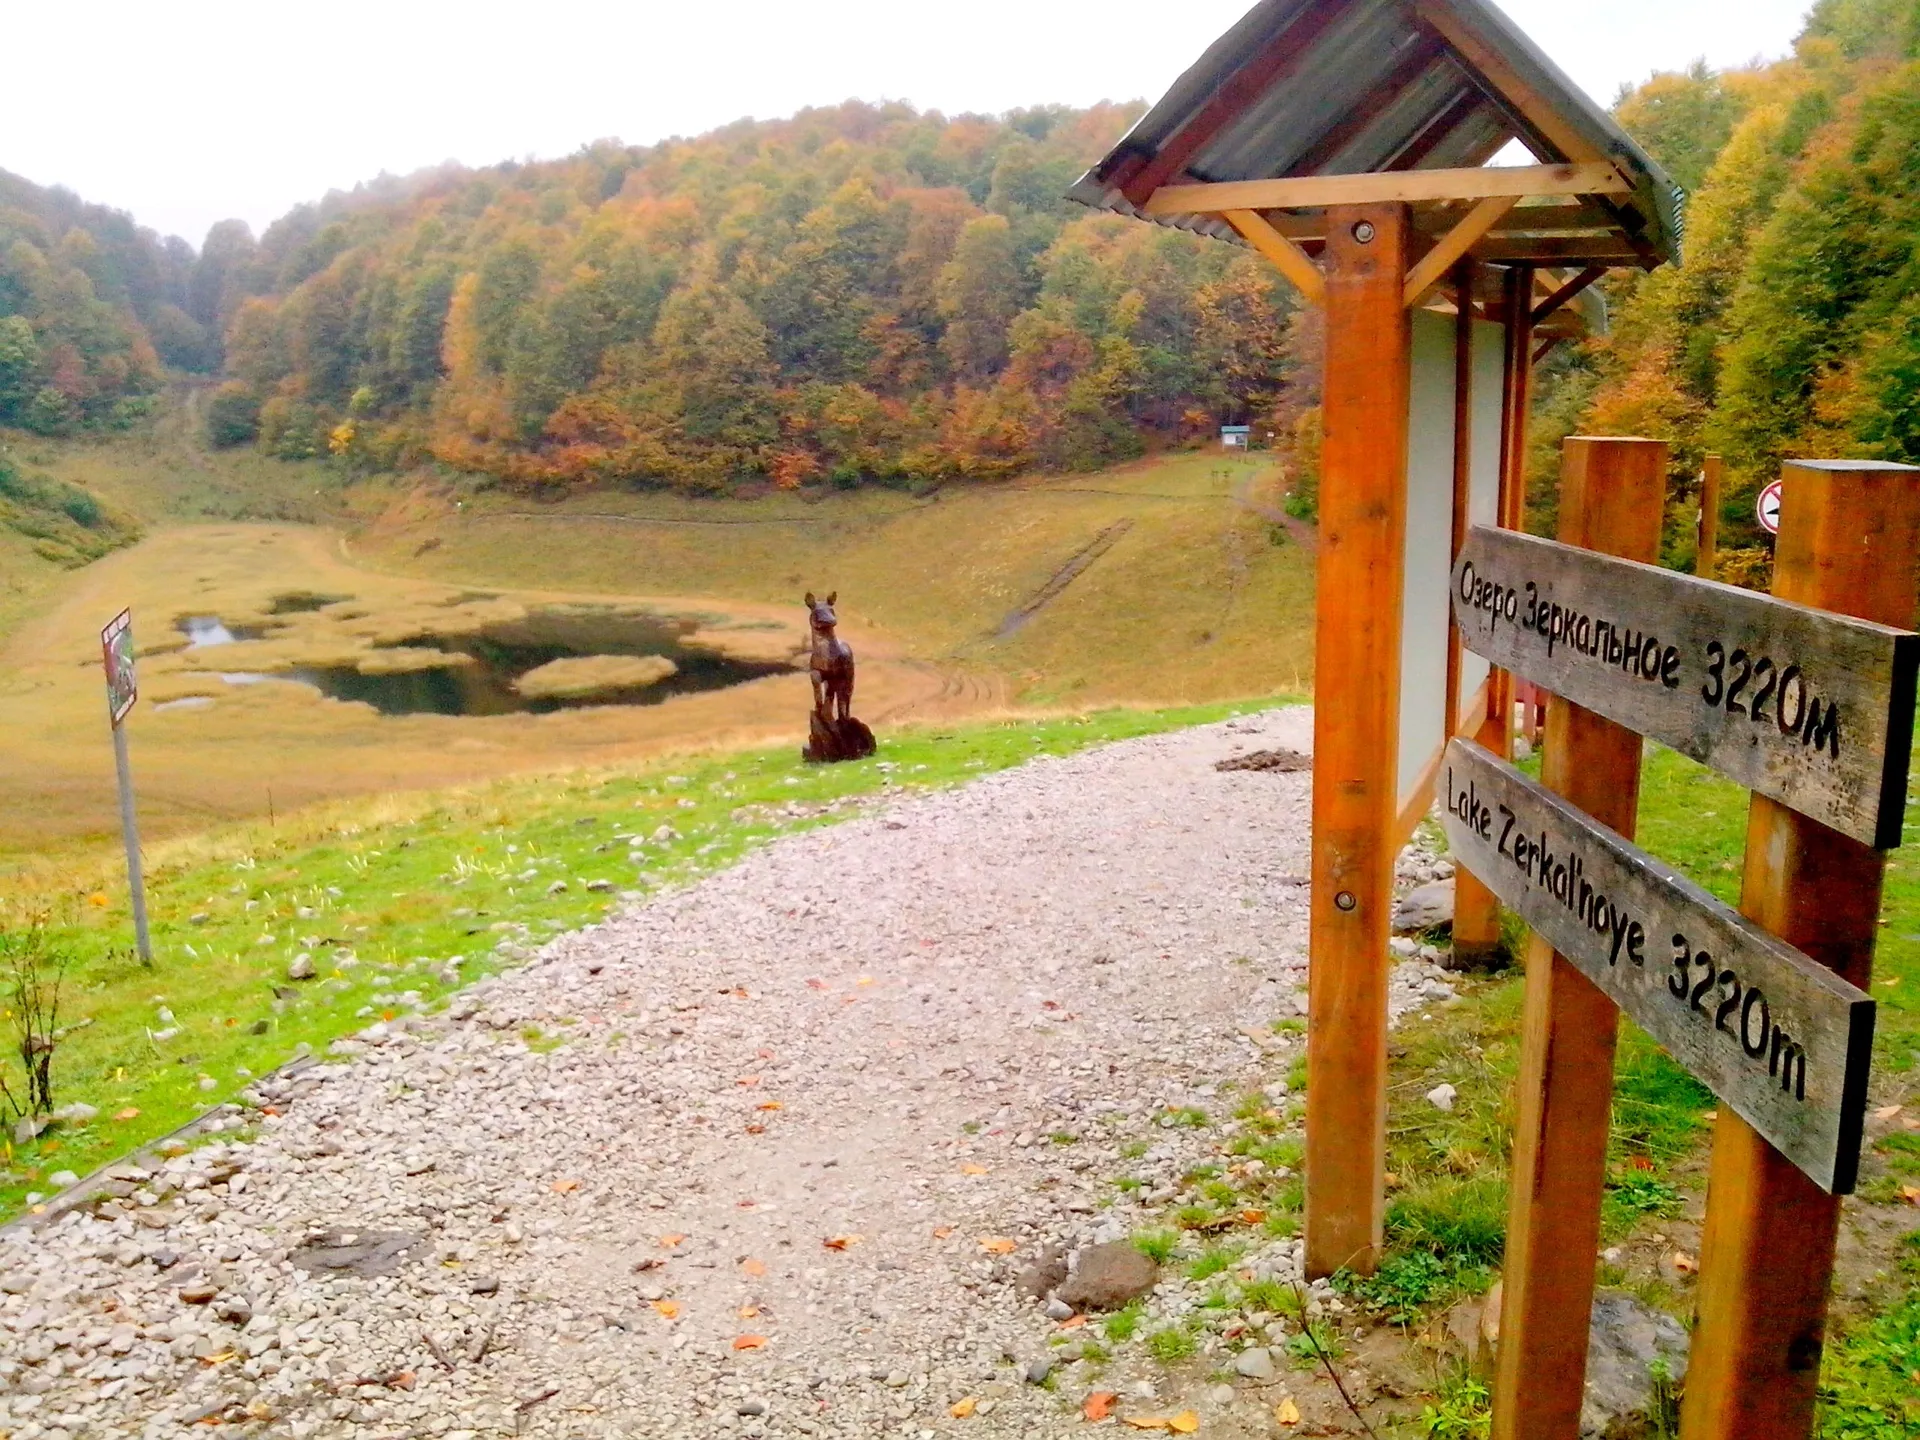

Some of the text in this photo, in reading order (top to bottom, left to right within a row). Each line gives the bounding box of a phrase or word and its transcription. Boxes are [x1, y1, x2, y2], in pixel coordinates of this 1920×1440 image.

[1460, 560, 1840, 759] Озеро Зеркальное 3220м
[1447, 766, 1806, 1101] Lake Zerkal'noye 3220m
